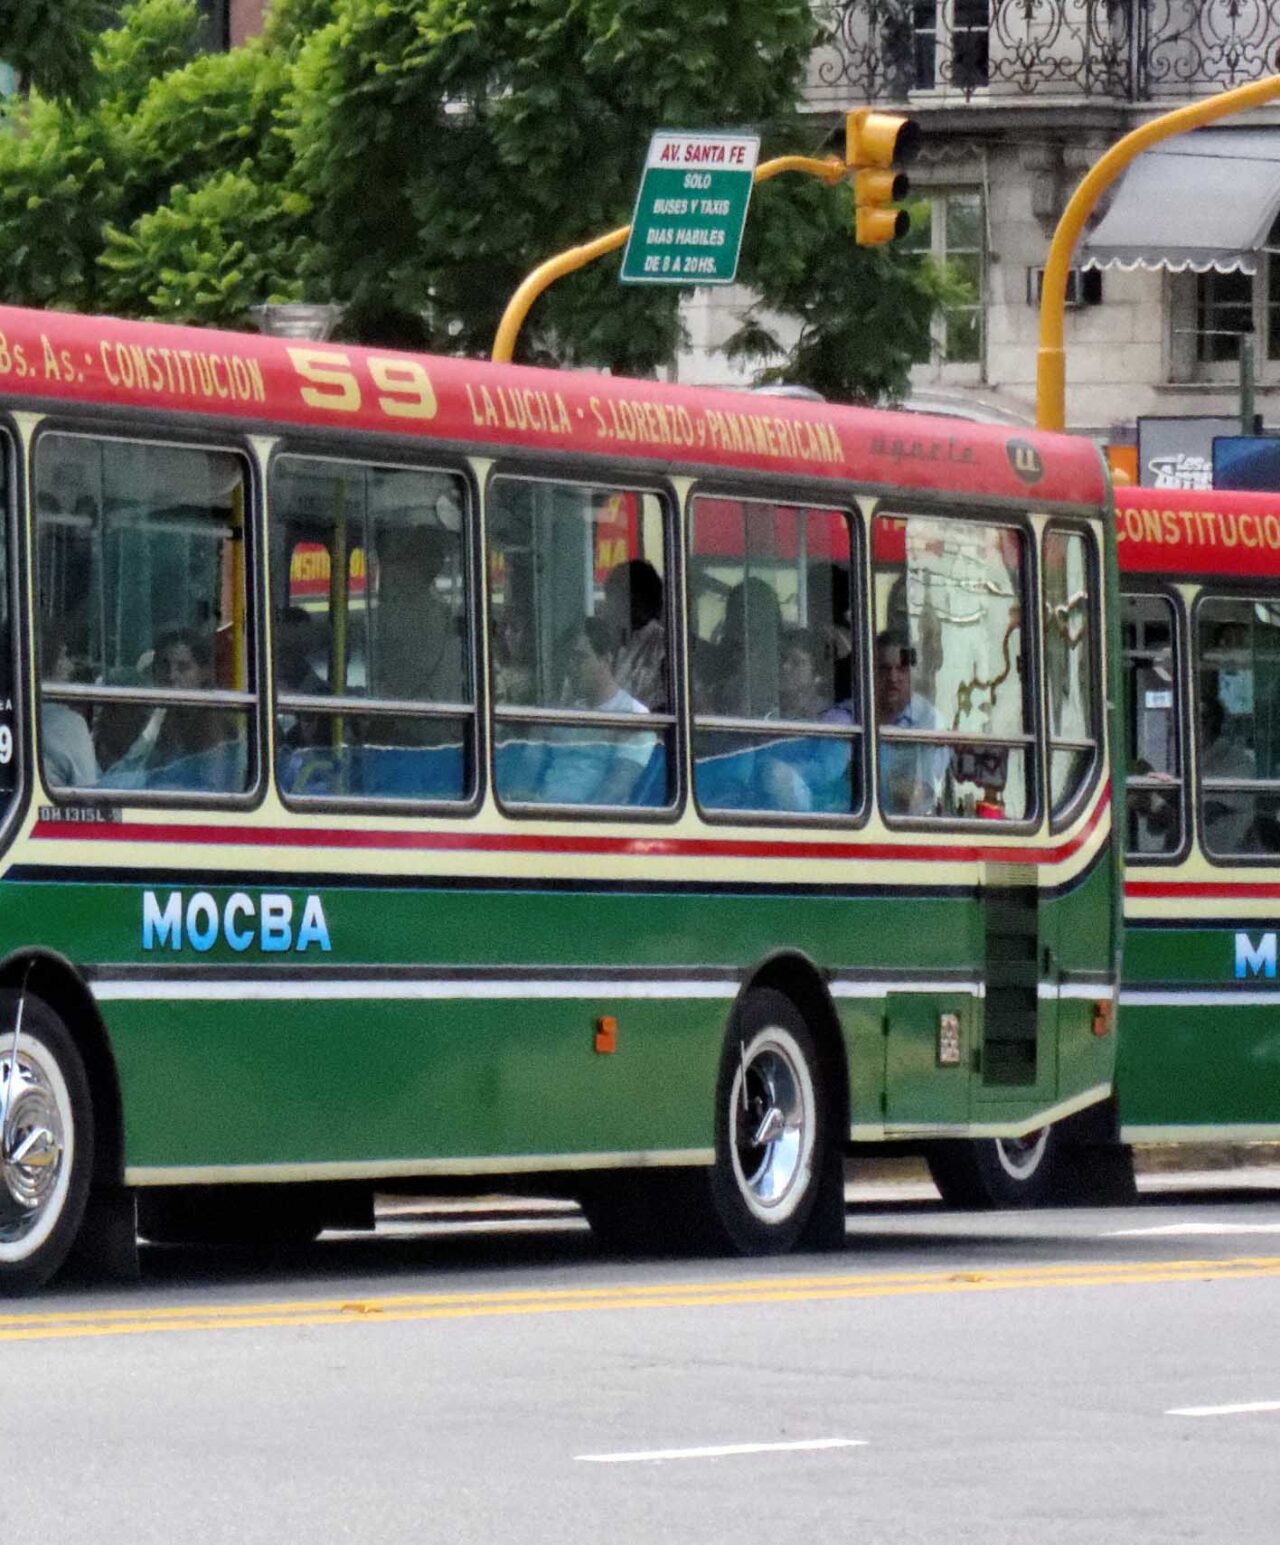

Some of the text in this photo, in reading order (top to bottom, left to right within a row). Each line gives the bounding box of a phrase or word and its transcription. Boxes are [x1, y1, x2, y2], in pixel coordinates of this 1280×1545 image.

[660, 144, 747, 164] AV. SANTA FE
[683, 173, 712, 189] SOLO
[652, 199, 730, 216] BUSES Y TAXIS
[646, 228, 725, 246] DIAS HABILES
[644, 255, 661, 272] DE
[672, 257, 681, 272] A
[100, 340, 265, 402] CONSTITUCION
[285, 346, 438, 420] 59
[465, 383, 499, 427] LA
[496, 387, 573, 434] LUCILA
[705, 409, 845, 464] PANAMERICANA
[142, 890, 332, 953] MOCBA
